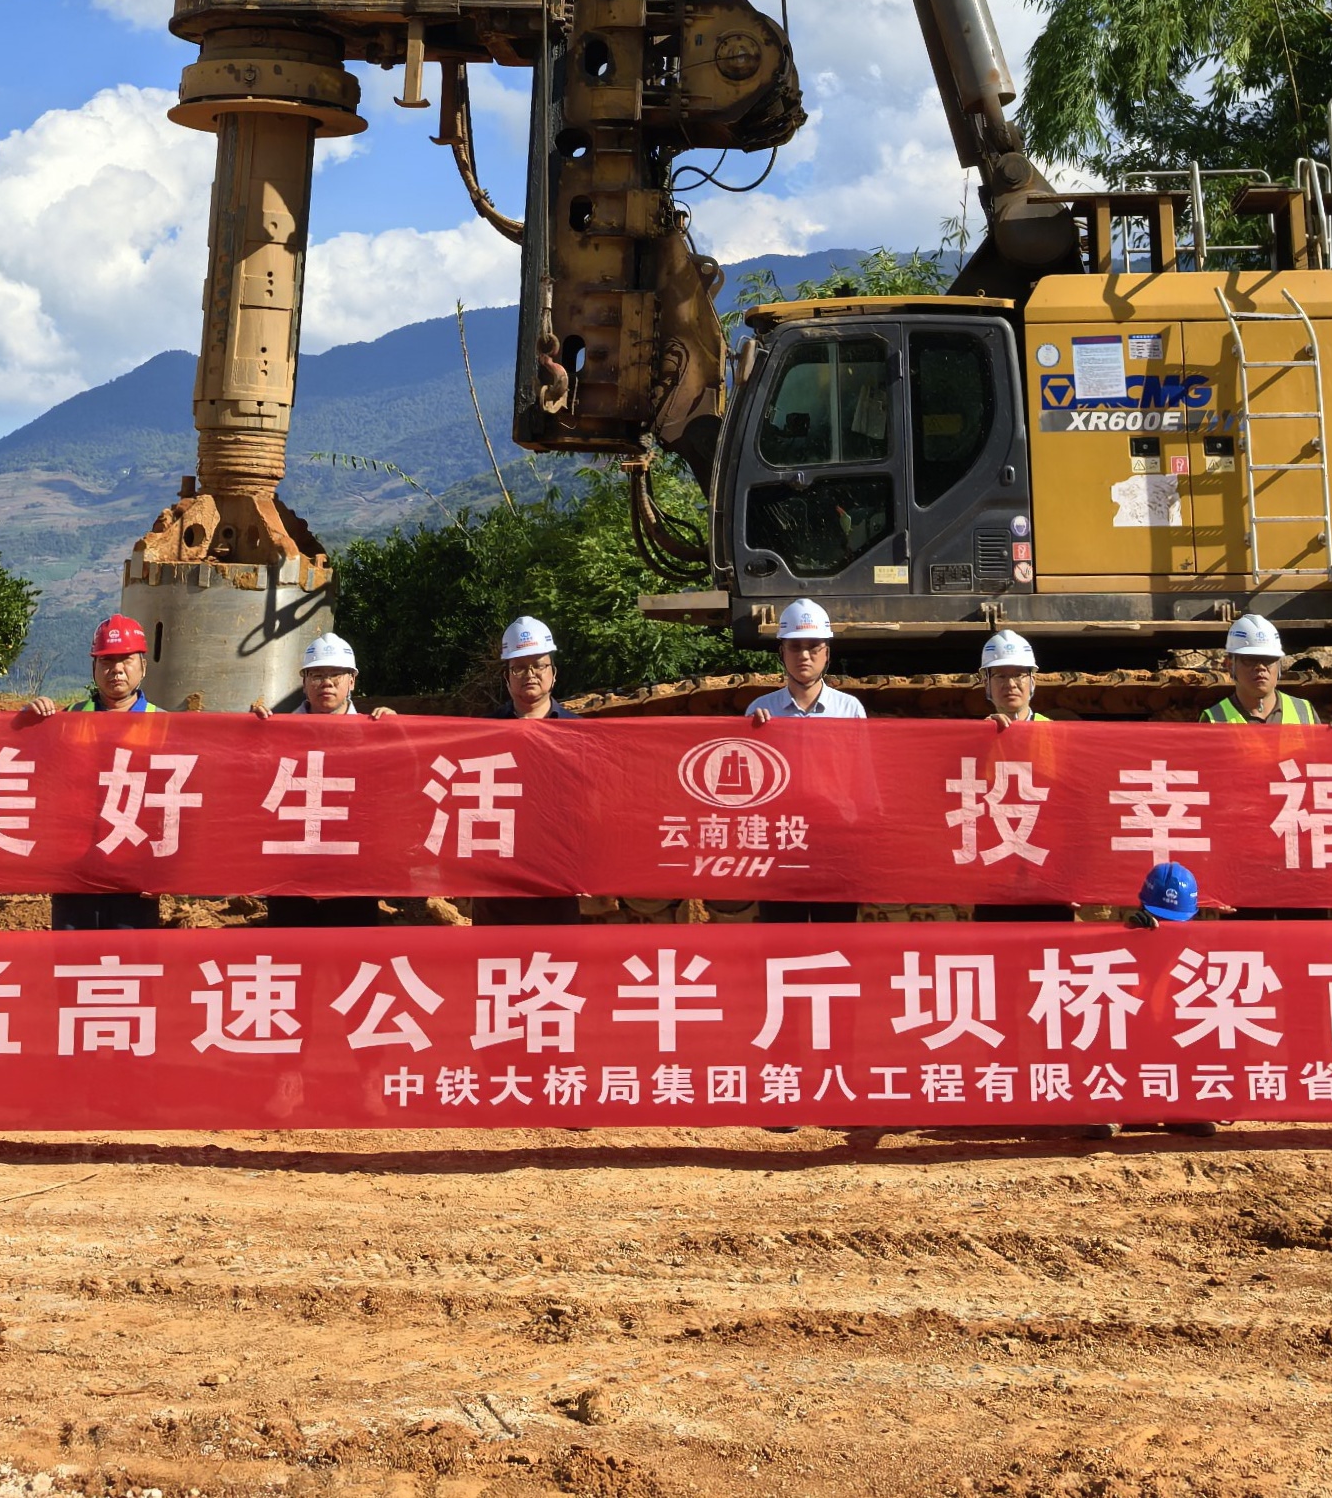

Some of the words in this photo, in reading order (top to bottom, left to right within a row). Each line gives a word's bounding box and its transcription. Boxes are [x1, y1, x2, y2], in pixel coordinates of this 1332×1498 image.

[1066, 411, 1181, 432] XR600E
[658, 813, 810, 851] 云南建投
[692, 855, 776, 877] YCIH
